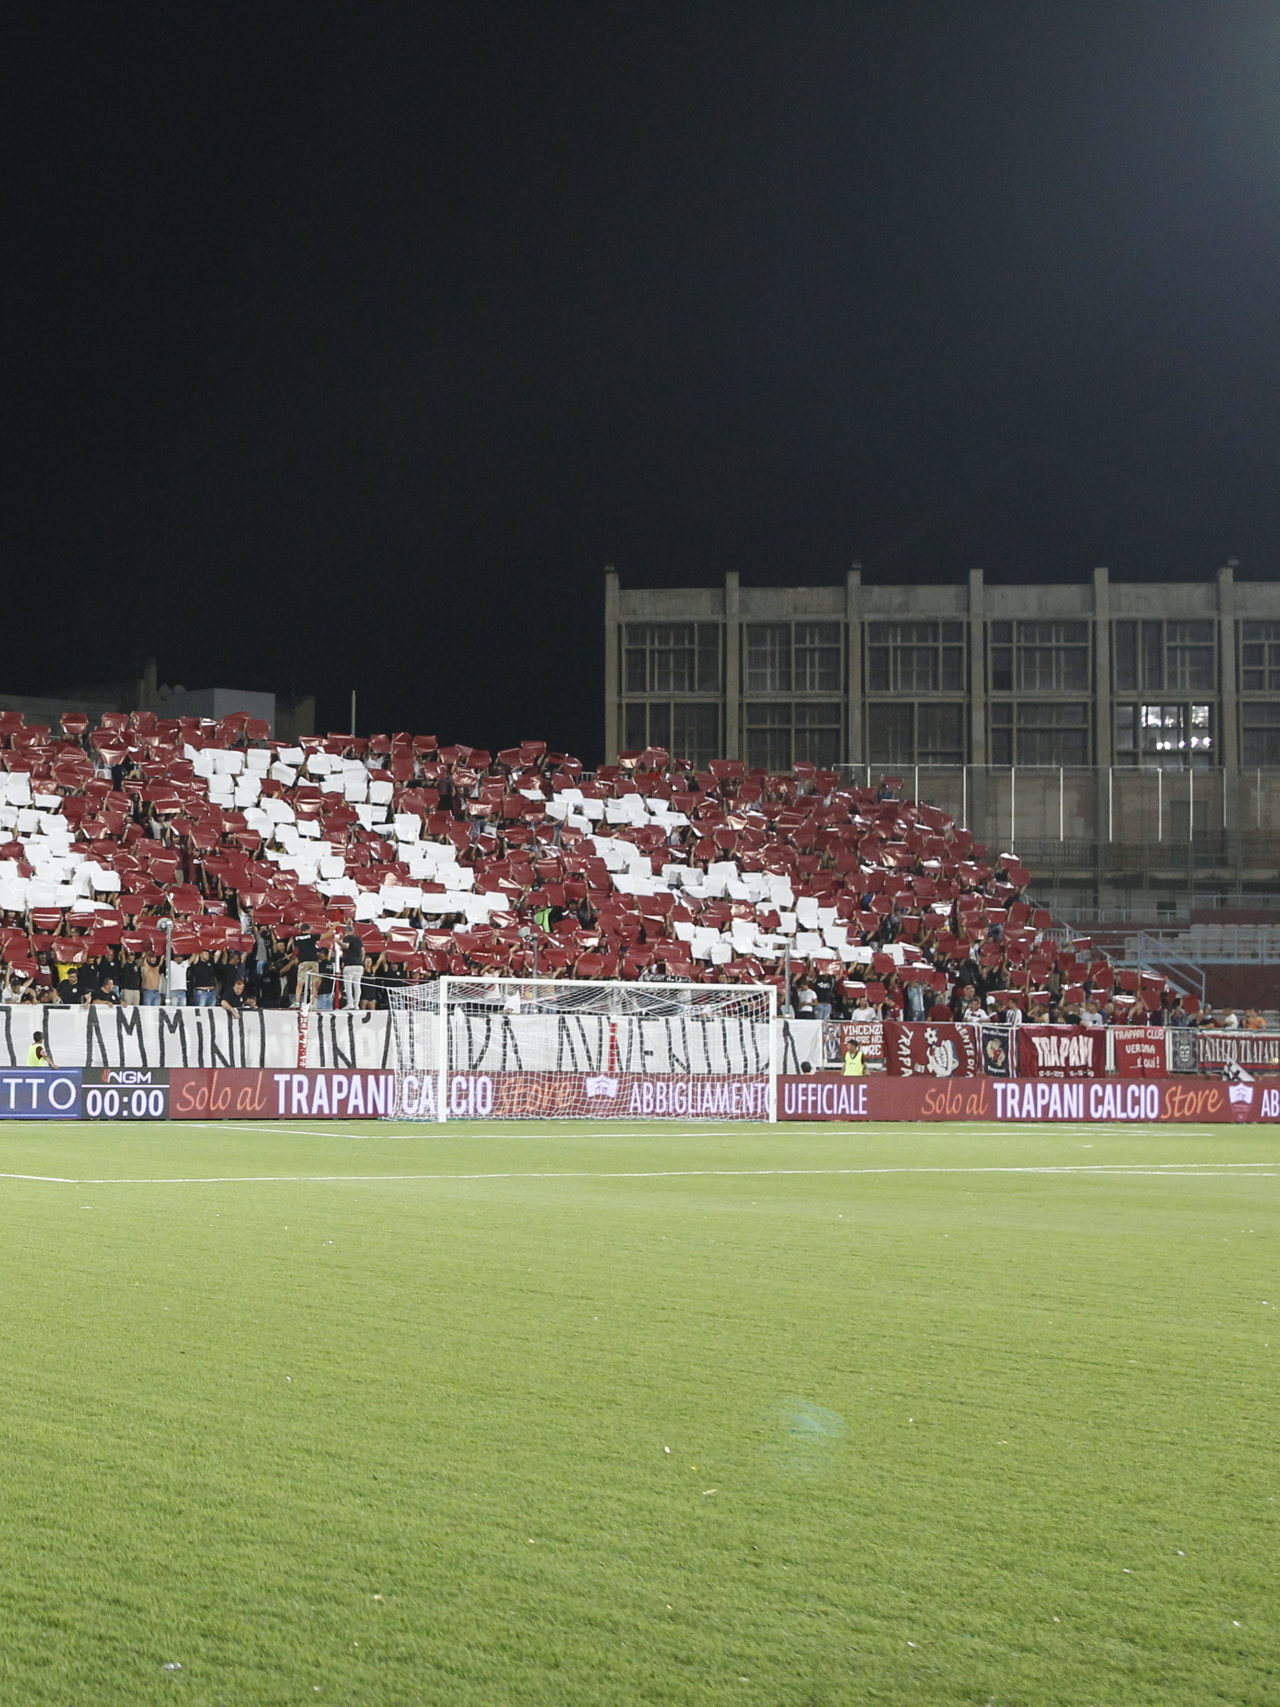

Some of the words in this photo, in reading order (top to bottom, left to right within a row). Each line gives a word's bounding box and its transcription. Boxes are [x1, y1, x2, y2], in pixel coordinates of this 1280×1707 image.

[1031, 1034, 1093, 1067] TRAPANI
[1125, 1043, 1156, 1054] VERONA
[107, 1071, 152, 1084] NGM
[176, 1068, 233, 1114] Solo
[238, 1068, 267, 1113] al
[274, 1073, 395, 1115] TRAPANI
[86, 1088, 165, 1117] 00:00
[784, 1083, 868, 1115] UFFICIALE
[920, 1079, 964, 1116] Solo
[965, 1079, 989, 1116] al
[993, 1082, 1084, 1119] TRAPANI
[1089, 1083, 1159, 1119] CALCIO
[1160, 1084, 1223, 1120] Store
